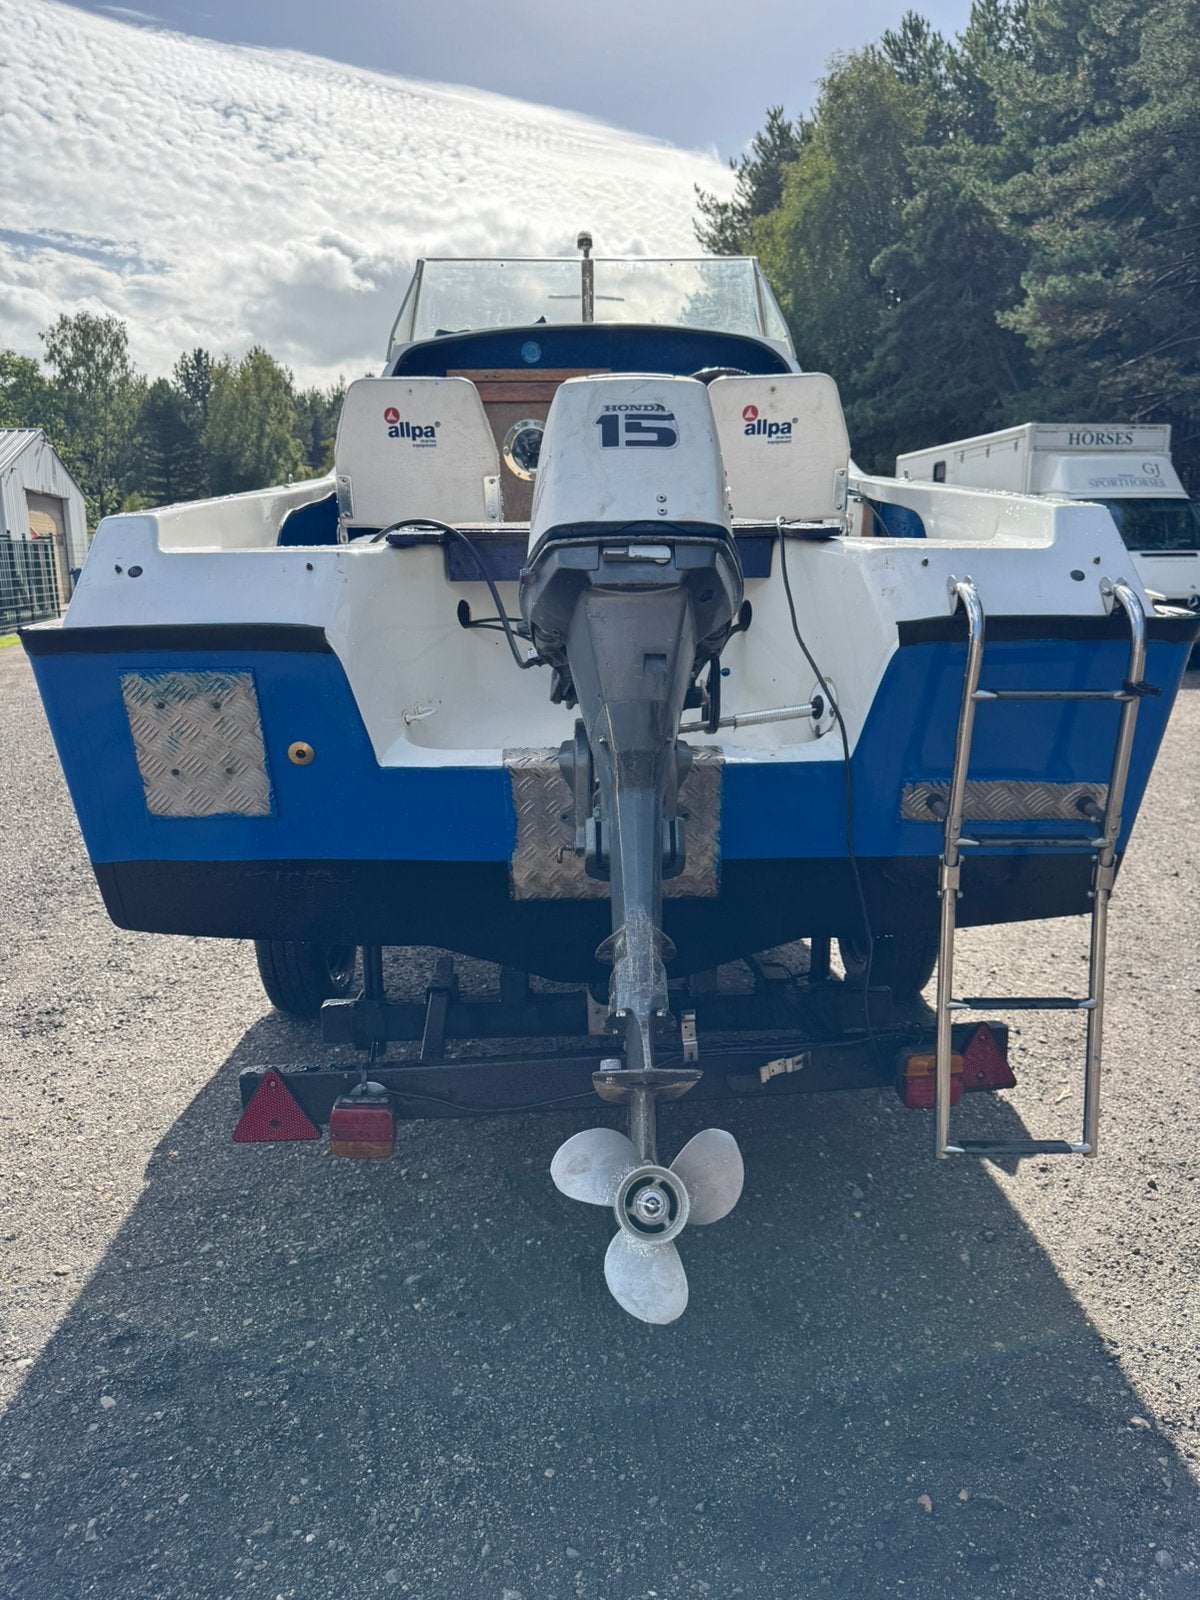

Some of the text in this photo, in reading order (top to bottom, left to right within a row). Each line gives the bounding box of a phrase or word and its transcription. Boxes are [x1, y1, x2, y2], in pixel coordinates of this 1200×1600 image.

[604, 403, 666, 412] HONDA
[595, 412, 677, 448] 15
[1068, 431, 1134, 446] HORSES
[1142, 462, 1161, 478] GJ
[1088, 477, 1166, 488] SPORTHORSES
